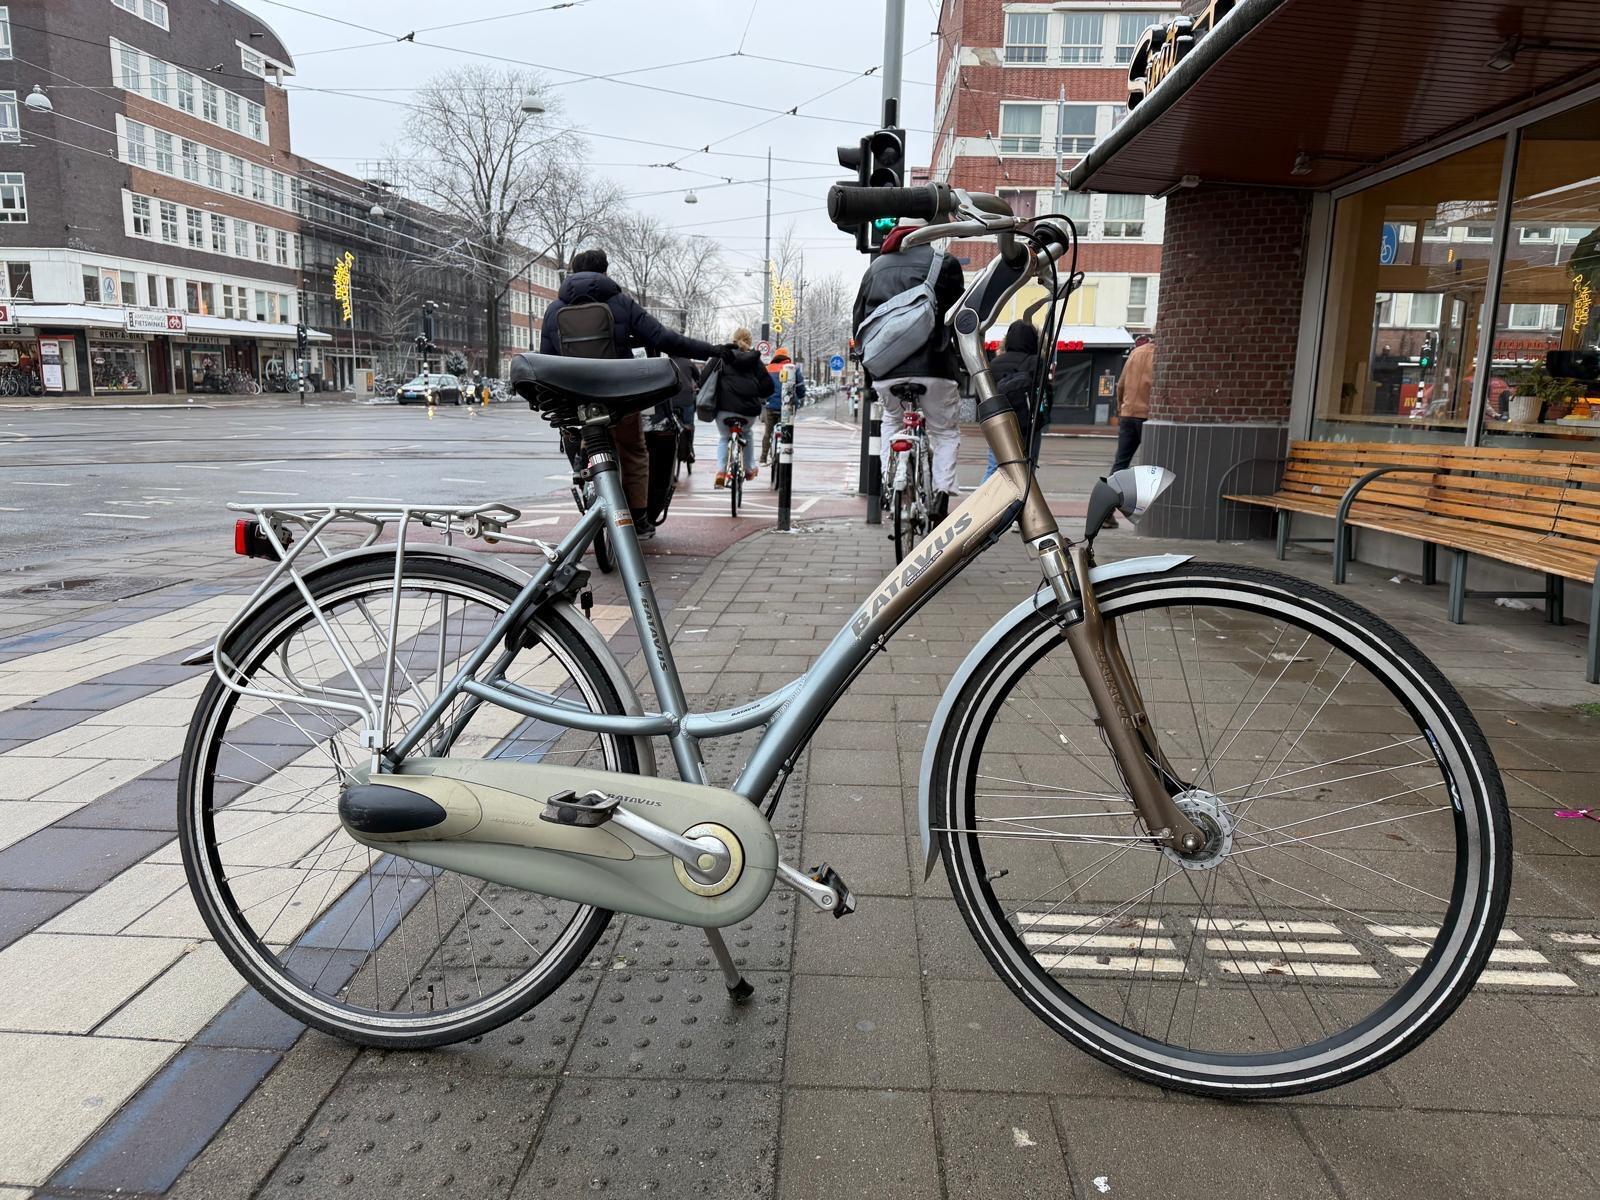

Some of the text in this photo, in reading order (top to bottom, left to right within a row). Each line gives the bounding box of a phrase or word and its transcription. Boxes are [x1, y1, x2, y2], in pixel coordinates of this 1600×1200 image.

[851, 512, 974, 636] BATAVUS
[641, 597, 668, 672] BATAVUS
[731, 704, 761, 716] BATAVUS
[607, 793, 664, 807] BATAVUS
